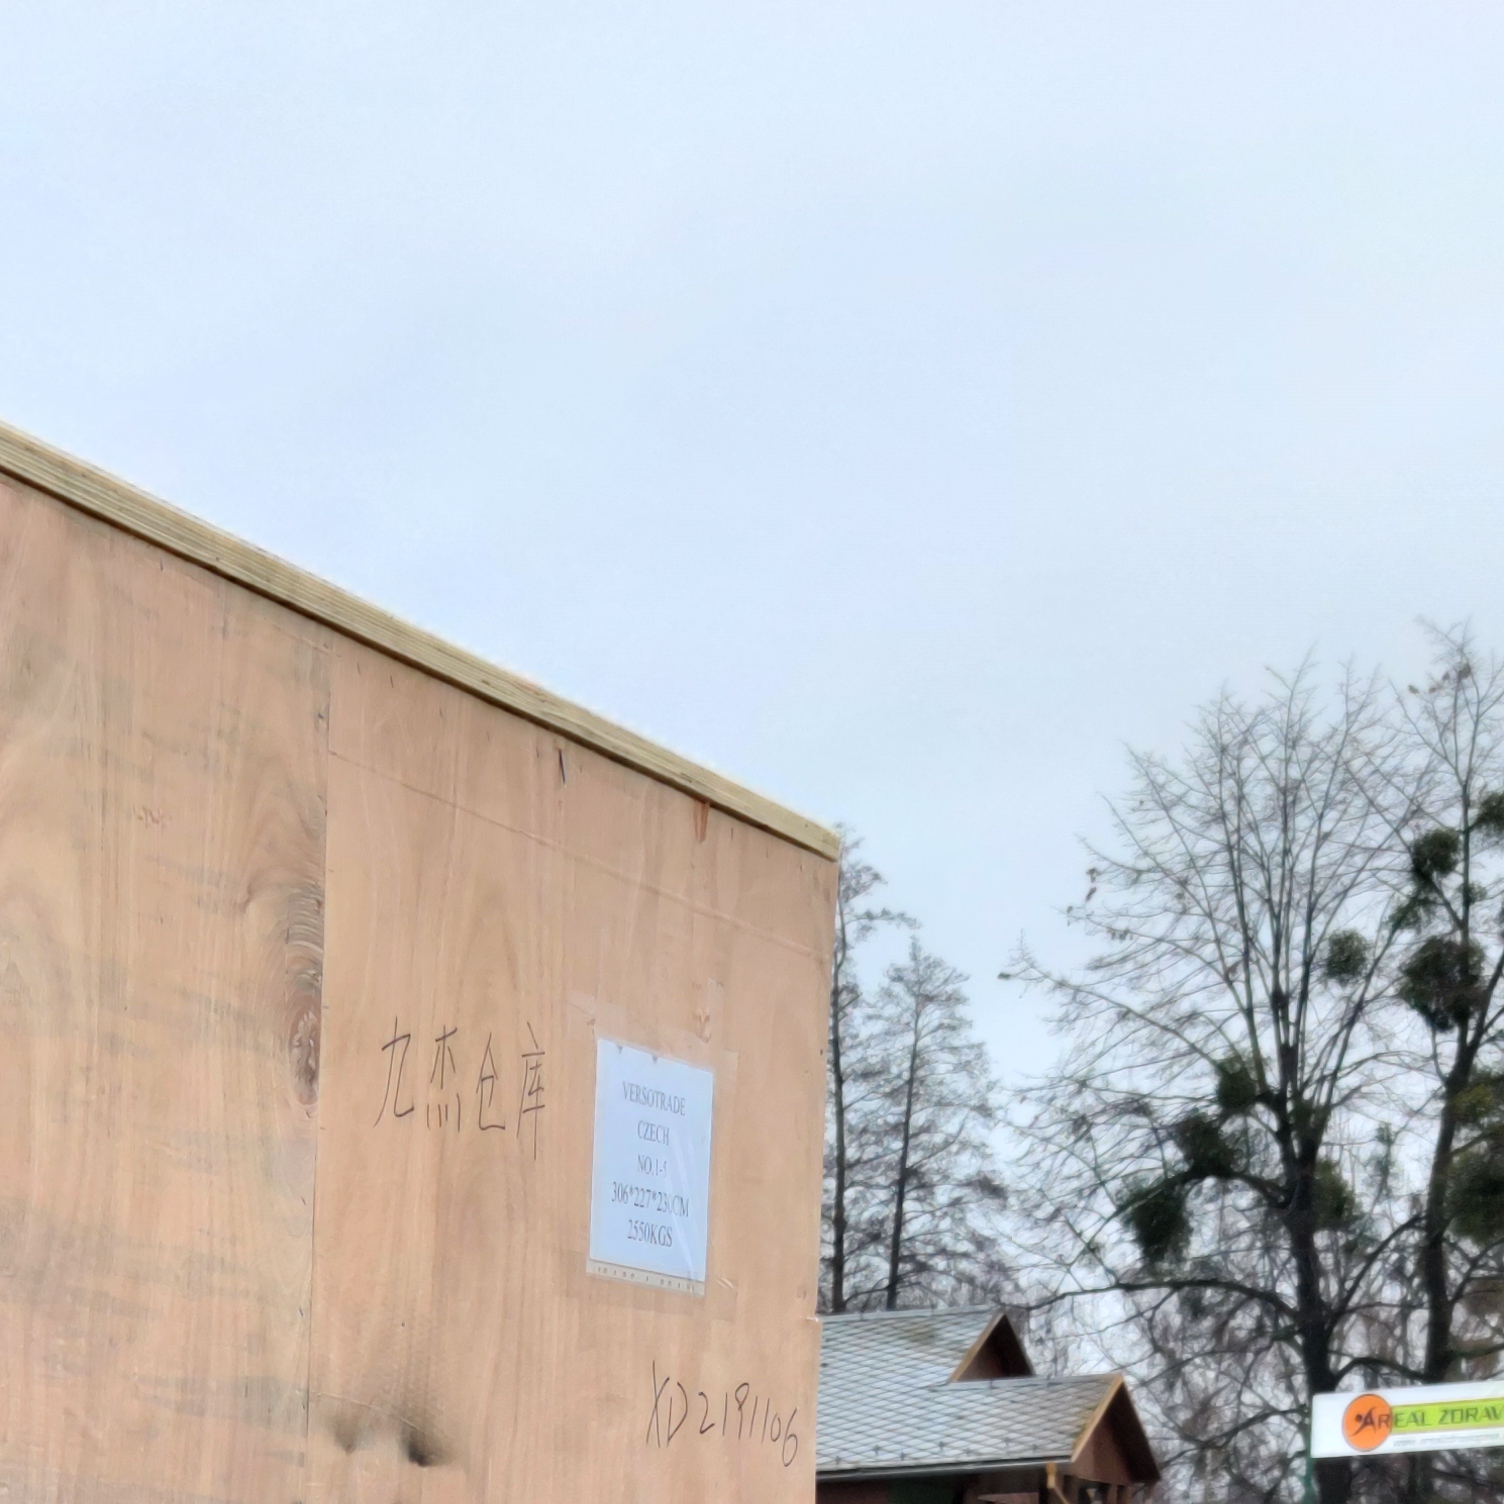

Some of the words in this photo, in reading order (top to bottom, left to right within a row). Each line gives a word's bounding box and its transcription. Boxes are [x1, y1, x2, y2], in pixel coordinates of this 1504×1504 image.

[622, 1081, 686, 1116] VERSOTRADE
[637, 1119, 670, 1146] CZECH
[637, 1154, 667, 1178] NO.1-5
[627, 1219, 673, 1248] 2550KGS
